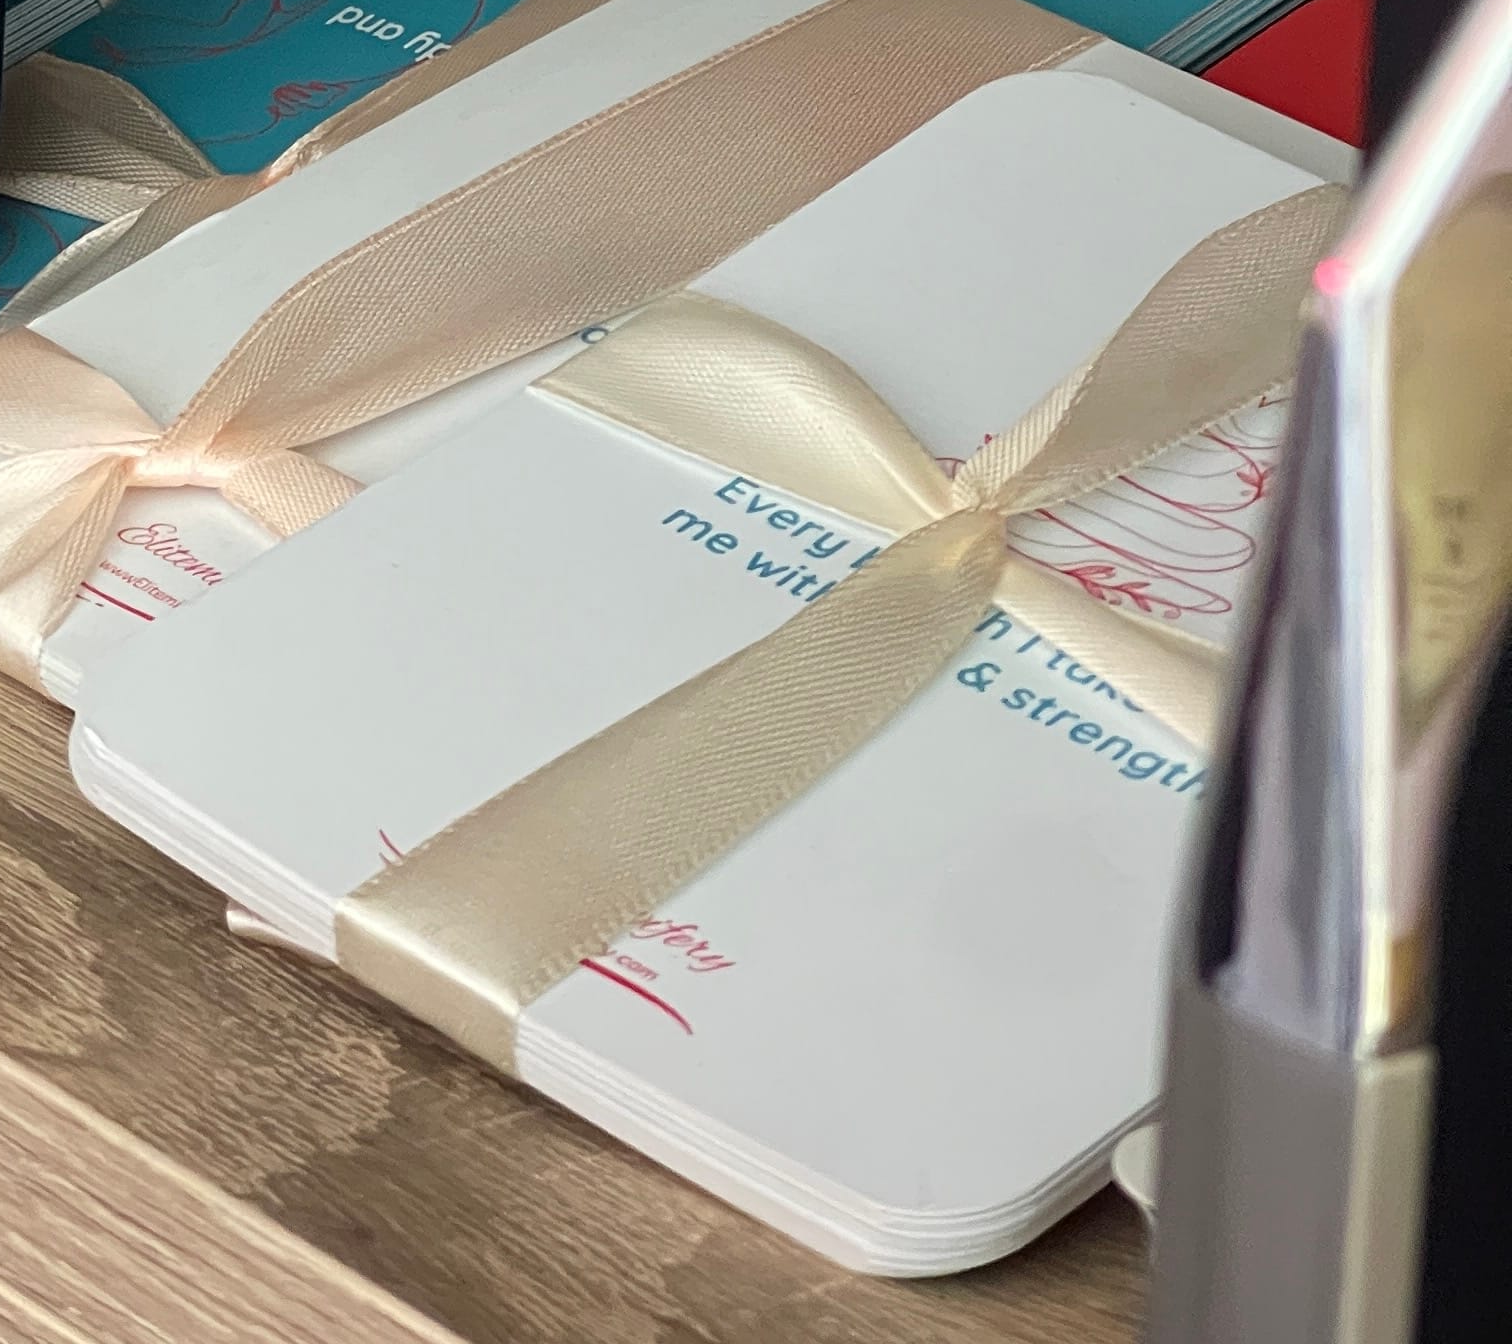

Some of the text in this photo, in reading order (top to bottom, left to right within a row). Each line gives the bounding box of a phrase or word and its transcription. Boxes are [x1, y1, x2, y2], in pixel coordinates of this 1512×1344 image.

[326, 5, 405, 41] and
[663, 508, 739, 556] me
[715, 475, 849, 561] Every
[956, 661, 999, 693] &
